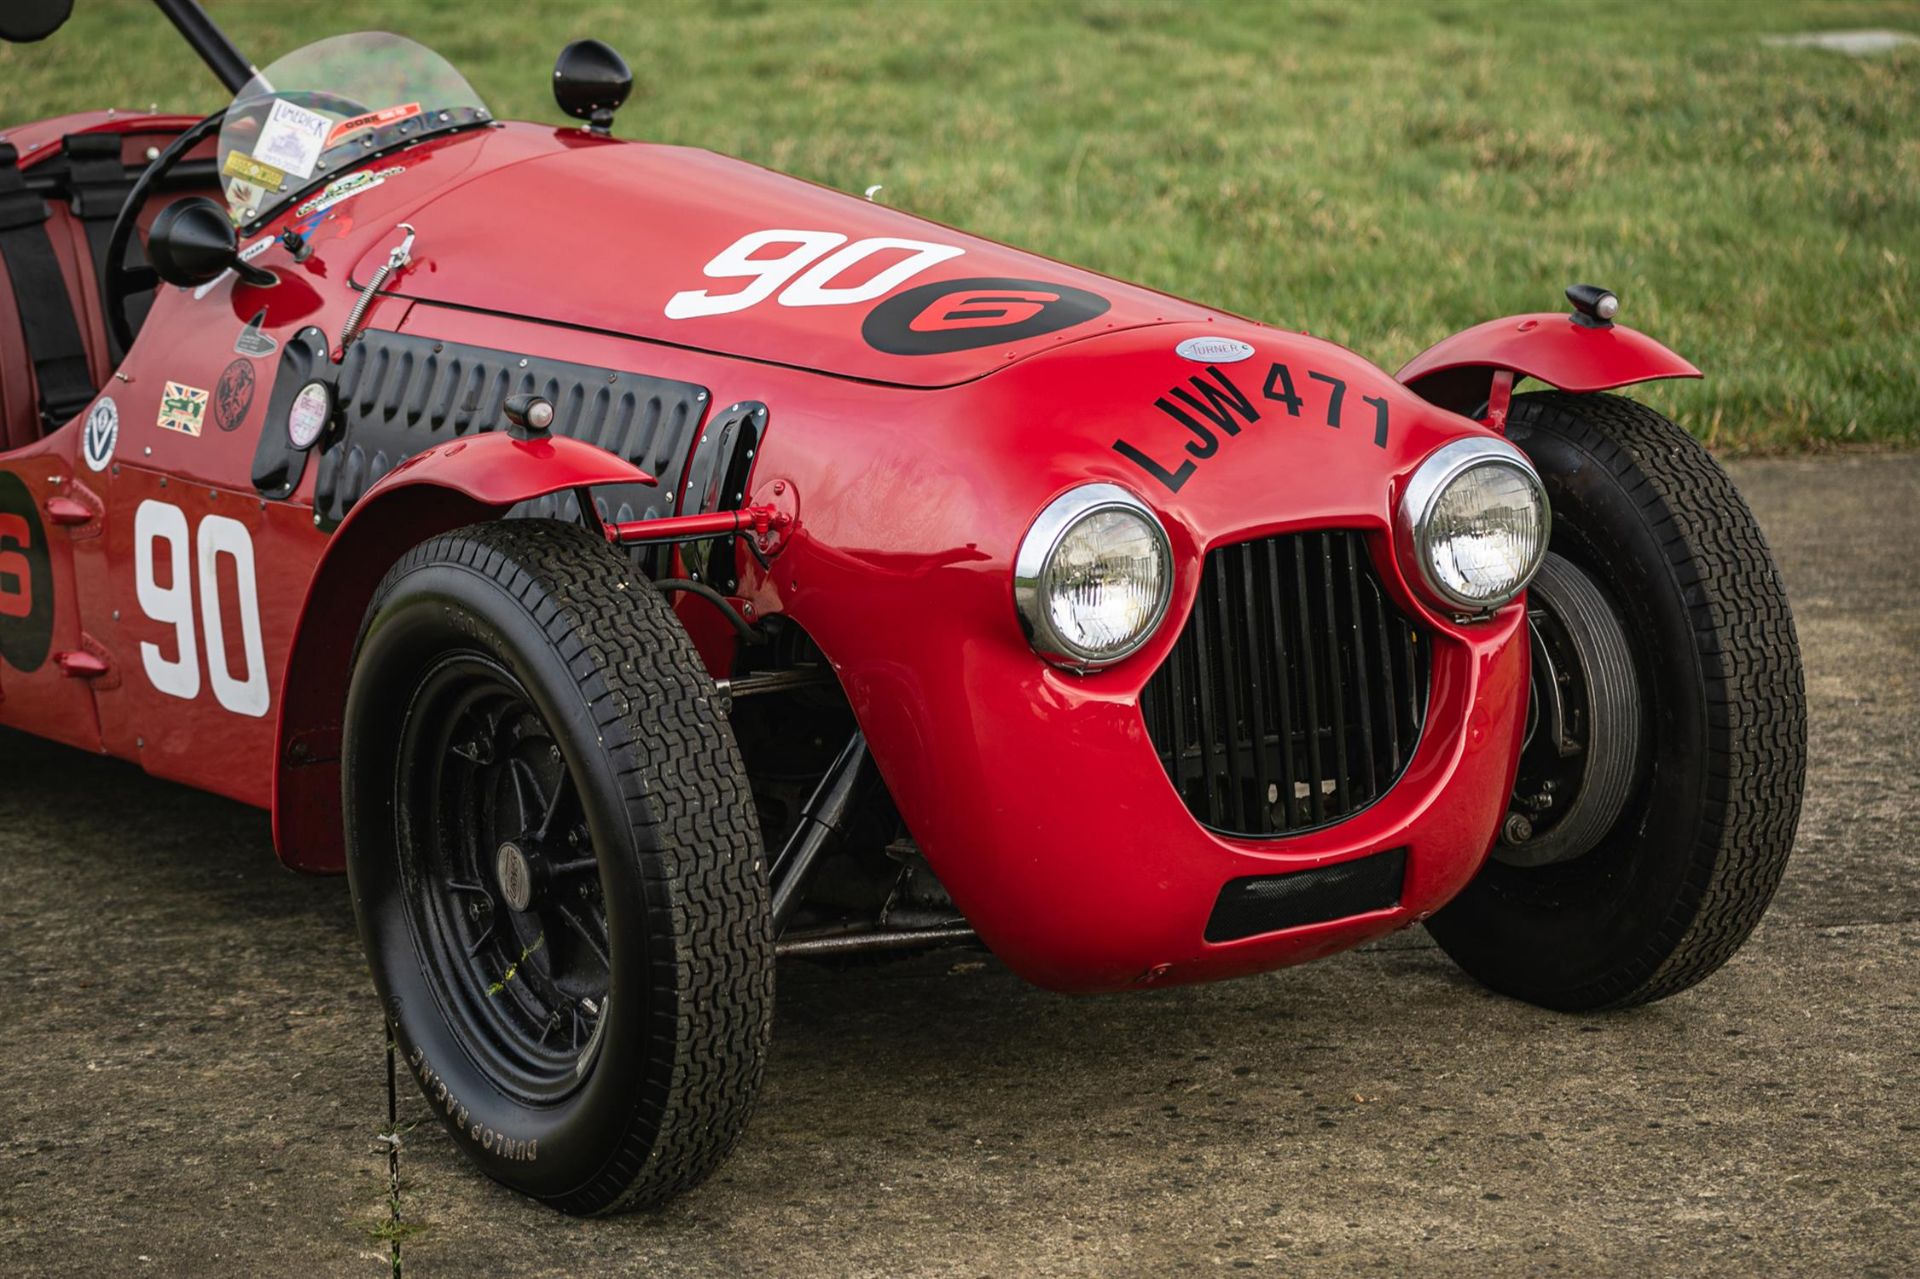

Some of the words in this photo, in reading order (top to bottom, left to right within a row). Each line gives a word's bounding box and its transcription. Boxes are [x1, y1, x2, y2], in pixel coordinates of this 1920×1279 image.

[664, 229, 966, 319] 90
[909, 290, 1060, 332] 6
[1189, 342, 1239, 355] TURNER
[1112, 365, 1261, 494] LJW
[1263, 363, 1389, 449] 471
[135, 499, 270, 717] 90
[471, 1122, 538, 1162] DUNLOP
